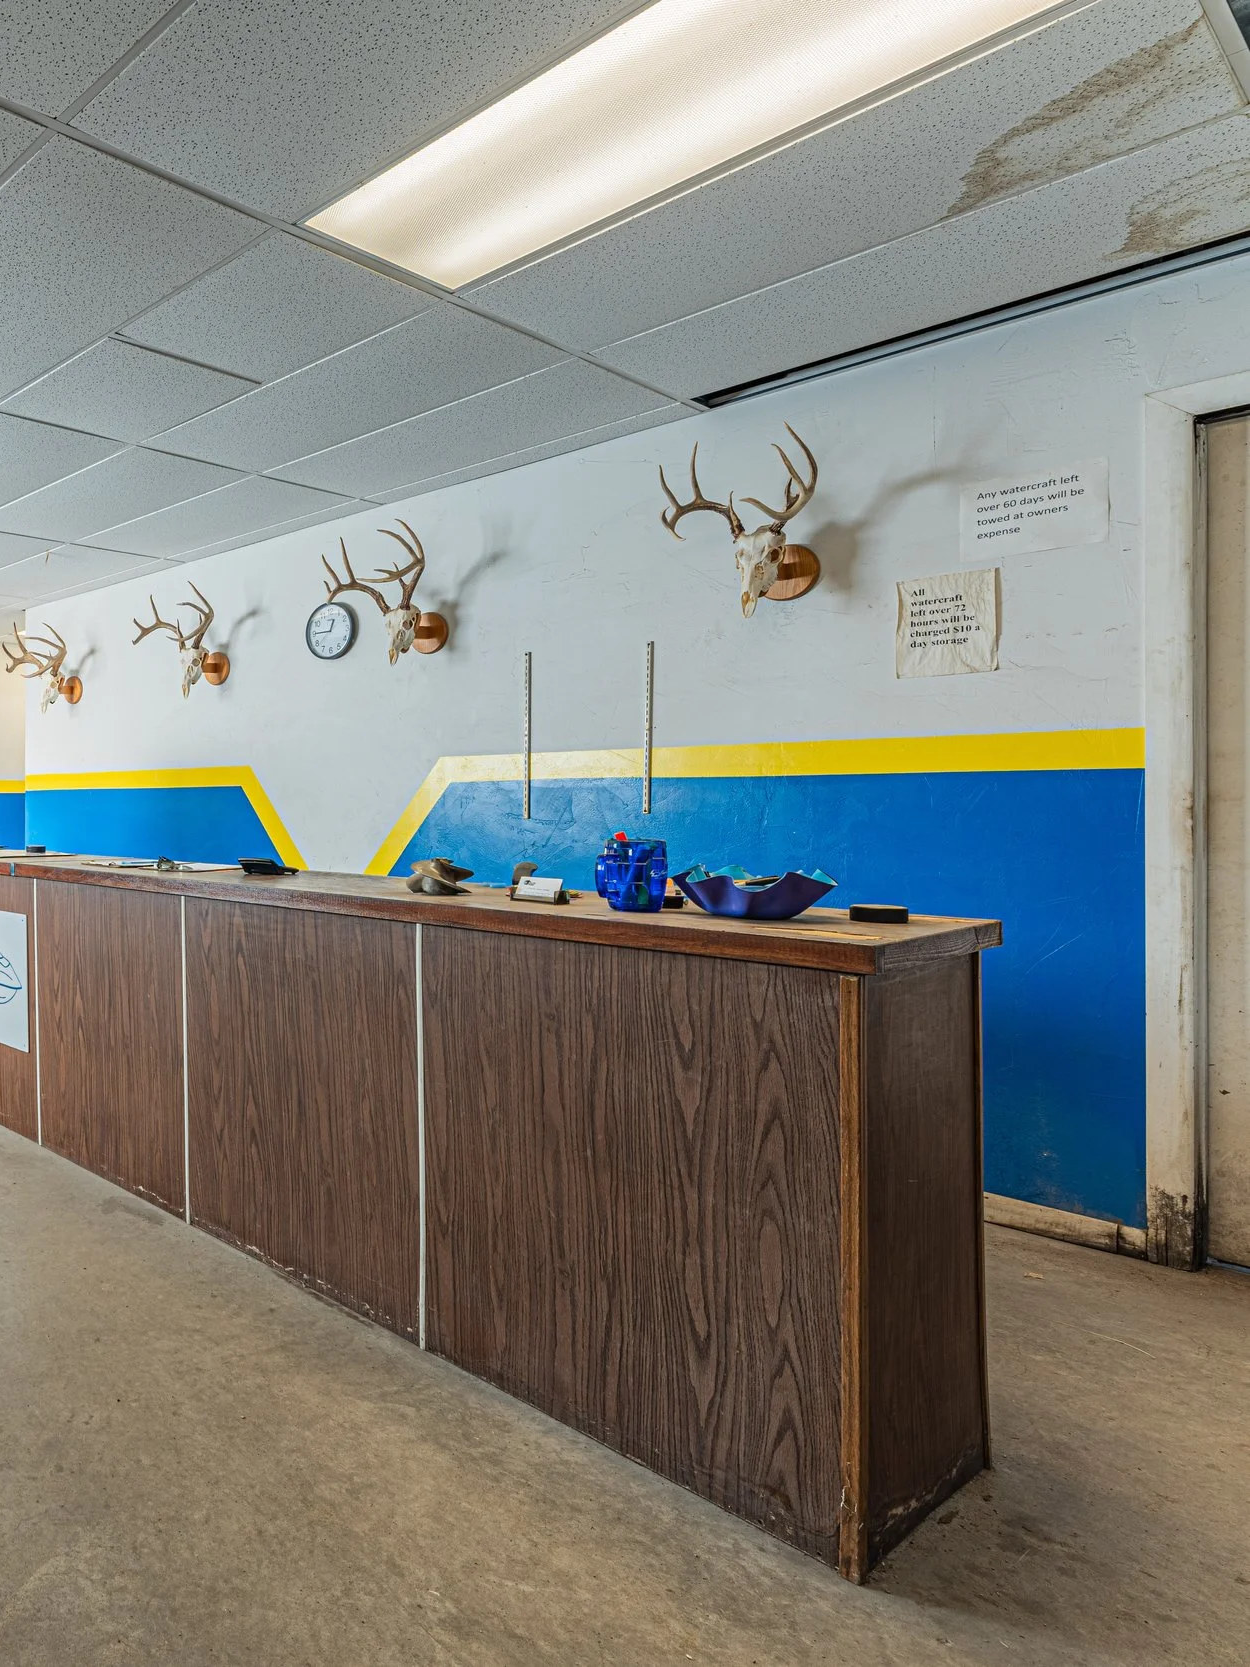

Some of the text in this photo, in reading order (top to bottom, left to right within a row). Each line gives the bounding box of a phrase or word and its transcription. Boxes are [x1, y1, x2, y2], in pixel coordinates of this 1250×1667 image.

[976, 474, 1080, 500] Any watercraft left
[976, 487, 1084, 514] over 60 days will be
[977, 506, 1068, 526] towed at owners
[976, 526, 1020, 540] expense
[910, 588, 925, 598] All
[910, 594, 962, 608] watercraft
[910, 608, 926, 618] left
[929, 606, 952, 616] over
[910, 614, 974, 628] hours will be
[910, 627, 950, 637] charged
[953, 624, 972, 634] $10
[910, 637, 968, 648] day storage
